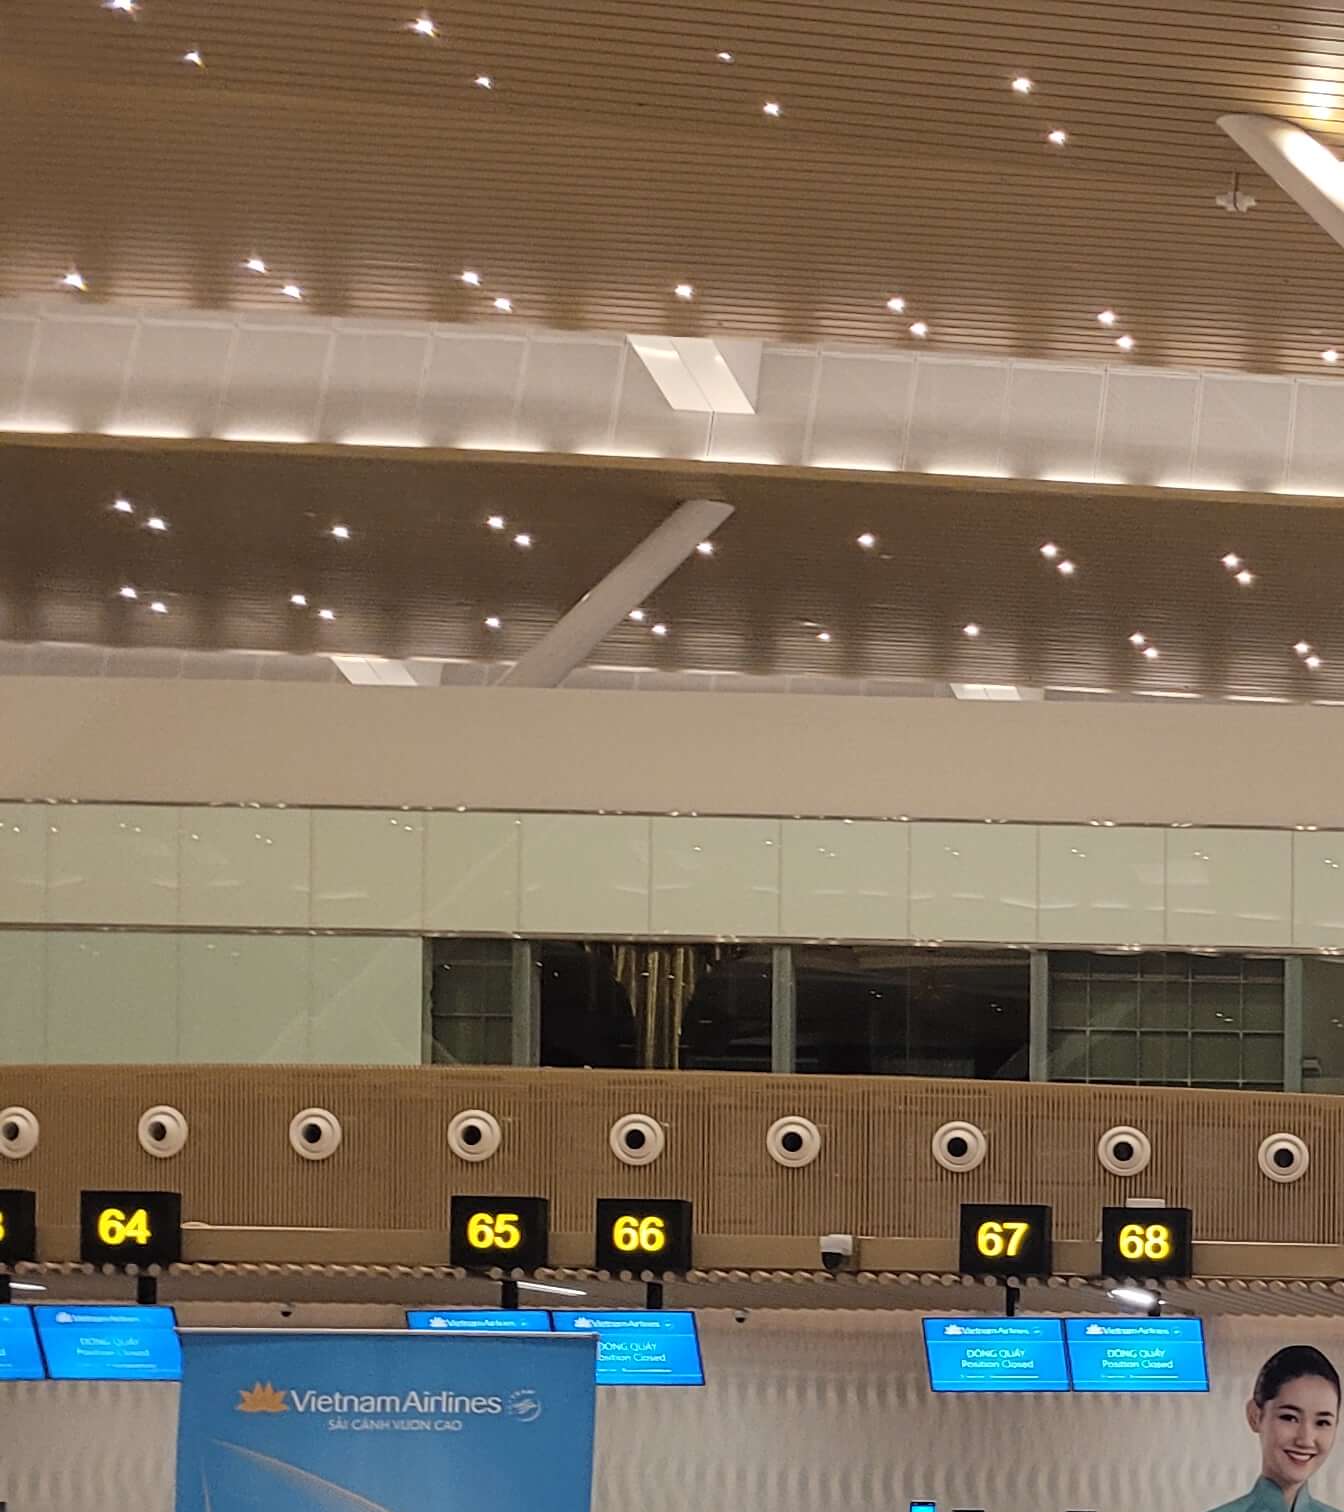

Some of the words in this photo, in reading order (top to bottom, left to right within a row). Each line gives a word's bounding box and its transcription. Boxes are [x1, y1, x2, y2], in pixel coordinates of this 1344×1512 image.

[98, 1208, 152, 1245] 64
[467, 1212, 521, 1249] 65
[613, 1215, 665, 1252] 66
[977, 1221, 1029, 1257] 67
[1119, 1224, 1171, 1260] 68
[598, 1353, 630, 1361] osition
[290, 1390, 401, 1413] Vietnam
[403, 1390, 503, 1414] Airlines
[434, 1419, 463, 1431] CAO
